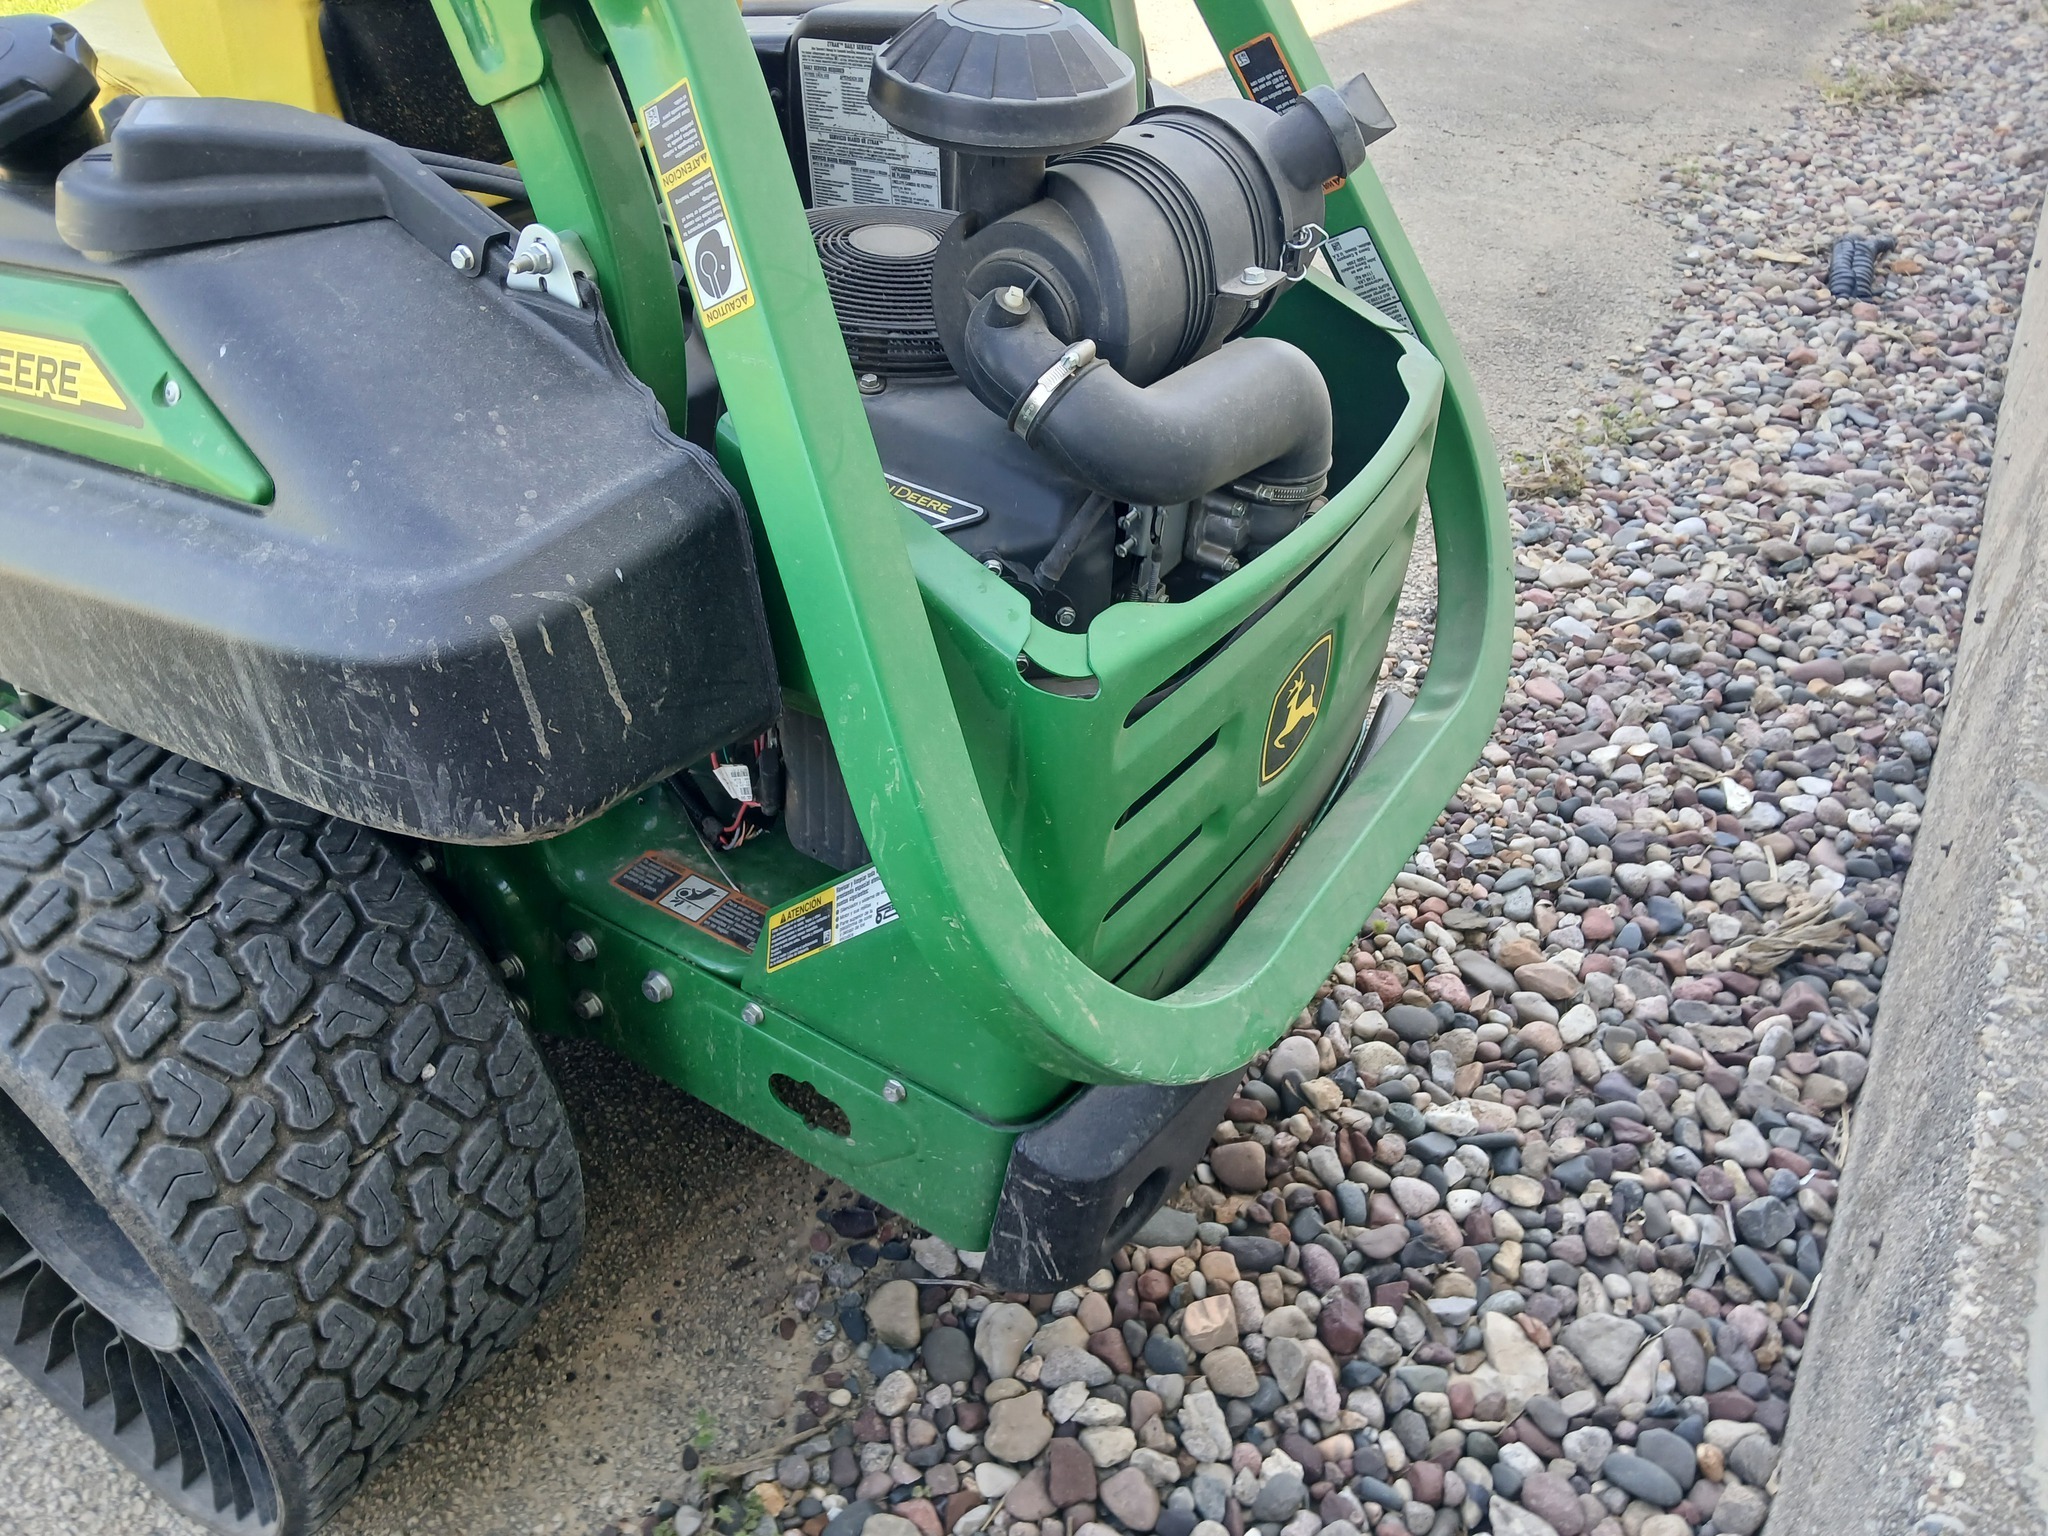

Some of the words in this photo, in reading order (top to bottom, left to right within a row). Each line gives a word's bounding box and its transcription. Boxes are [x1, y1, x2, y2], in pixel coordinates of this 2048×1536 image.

[662, 160, 701, 187] ATENCIÓN
[706, 298, 741, 321] CAUTION
[894, 486, 953, 515] DEERE
[787, 897, 821, 919] ATENCIÓN
